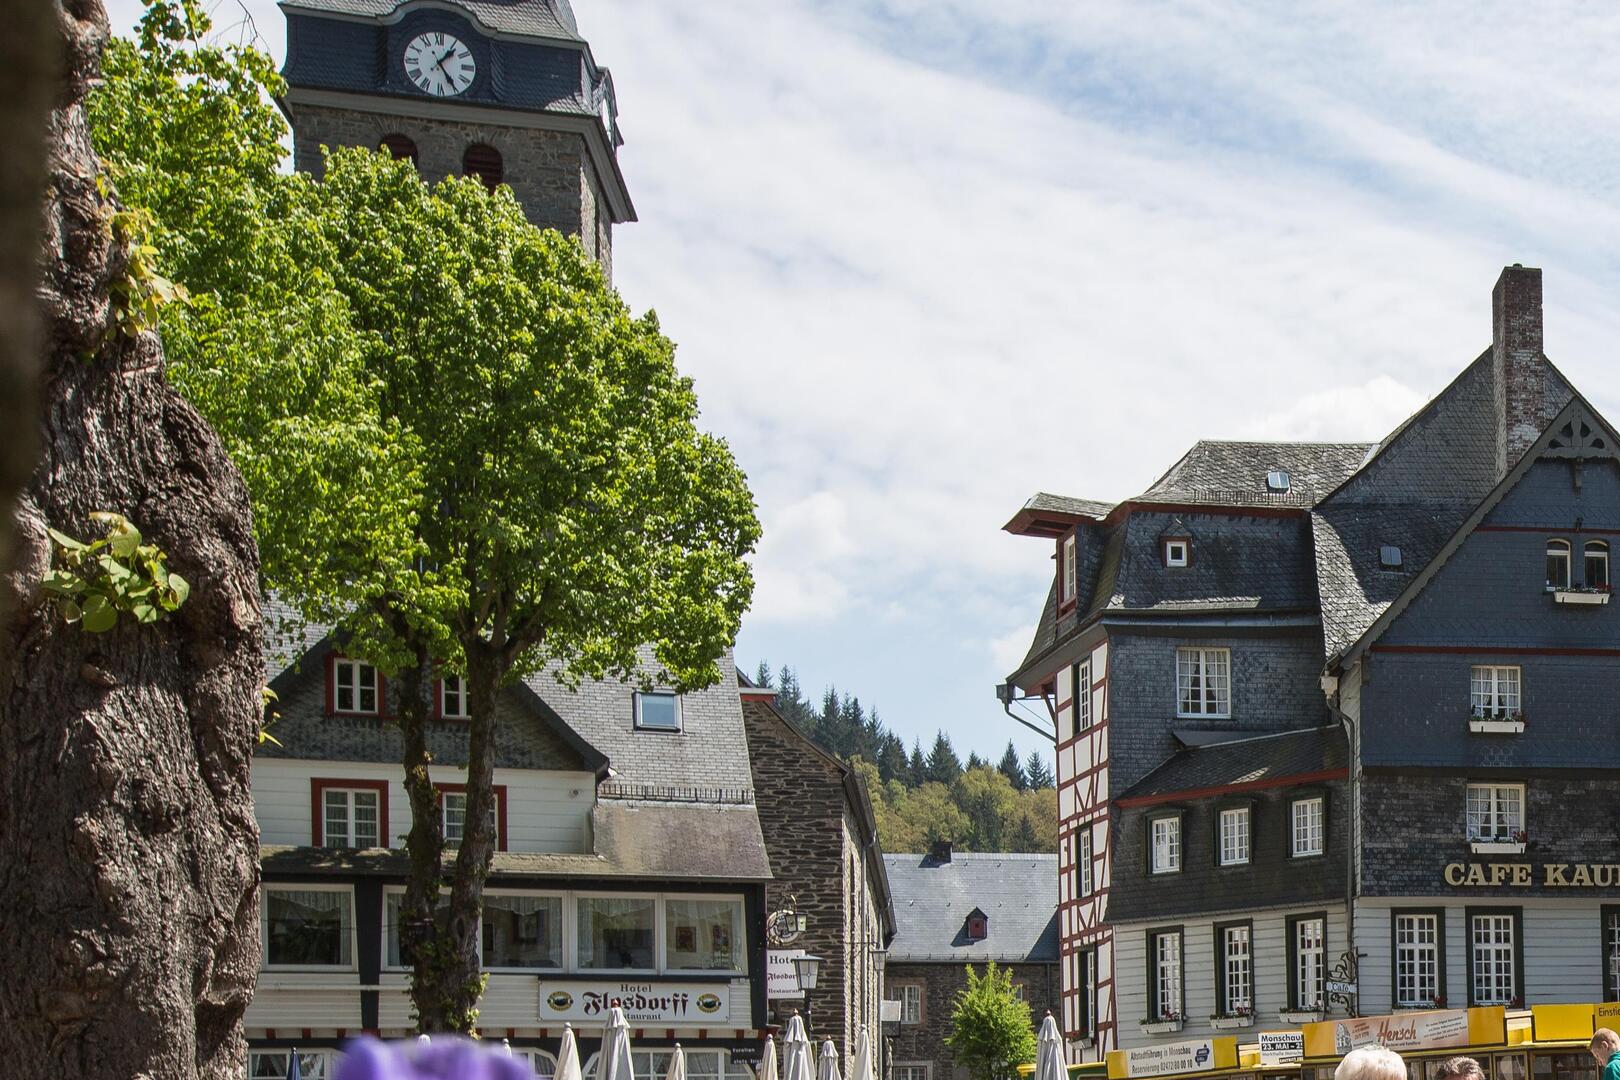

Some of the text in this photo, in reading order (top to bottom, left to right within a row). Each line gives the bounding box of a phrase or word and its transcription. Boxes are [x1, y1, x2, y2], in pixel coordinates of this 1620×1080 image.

[1444, 863, 1531, 886] CAFE
[769, 955, 792, 964] Hot
[768, 973, 795, 981] Flosdor
[620, 984, 652, 992] Hotel
[1376, 1018, 1416, 1046] Hensch
[1261, 1034, 1301, 1042] Monschau
